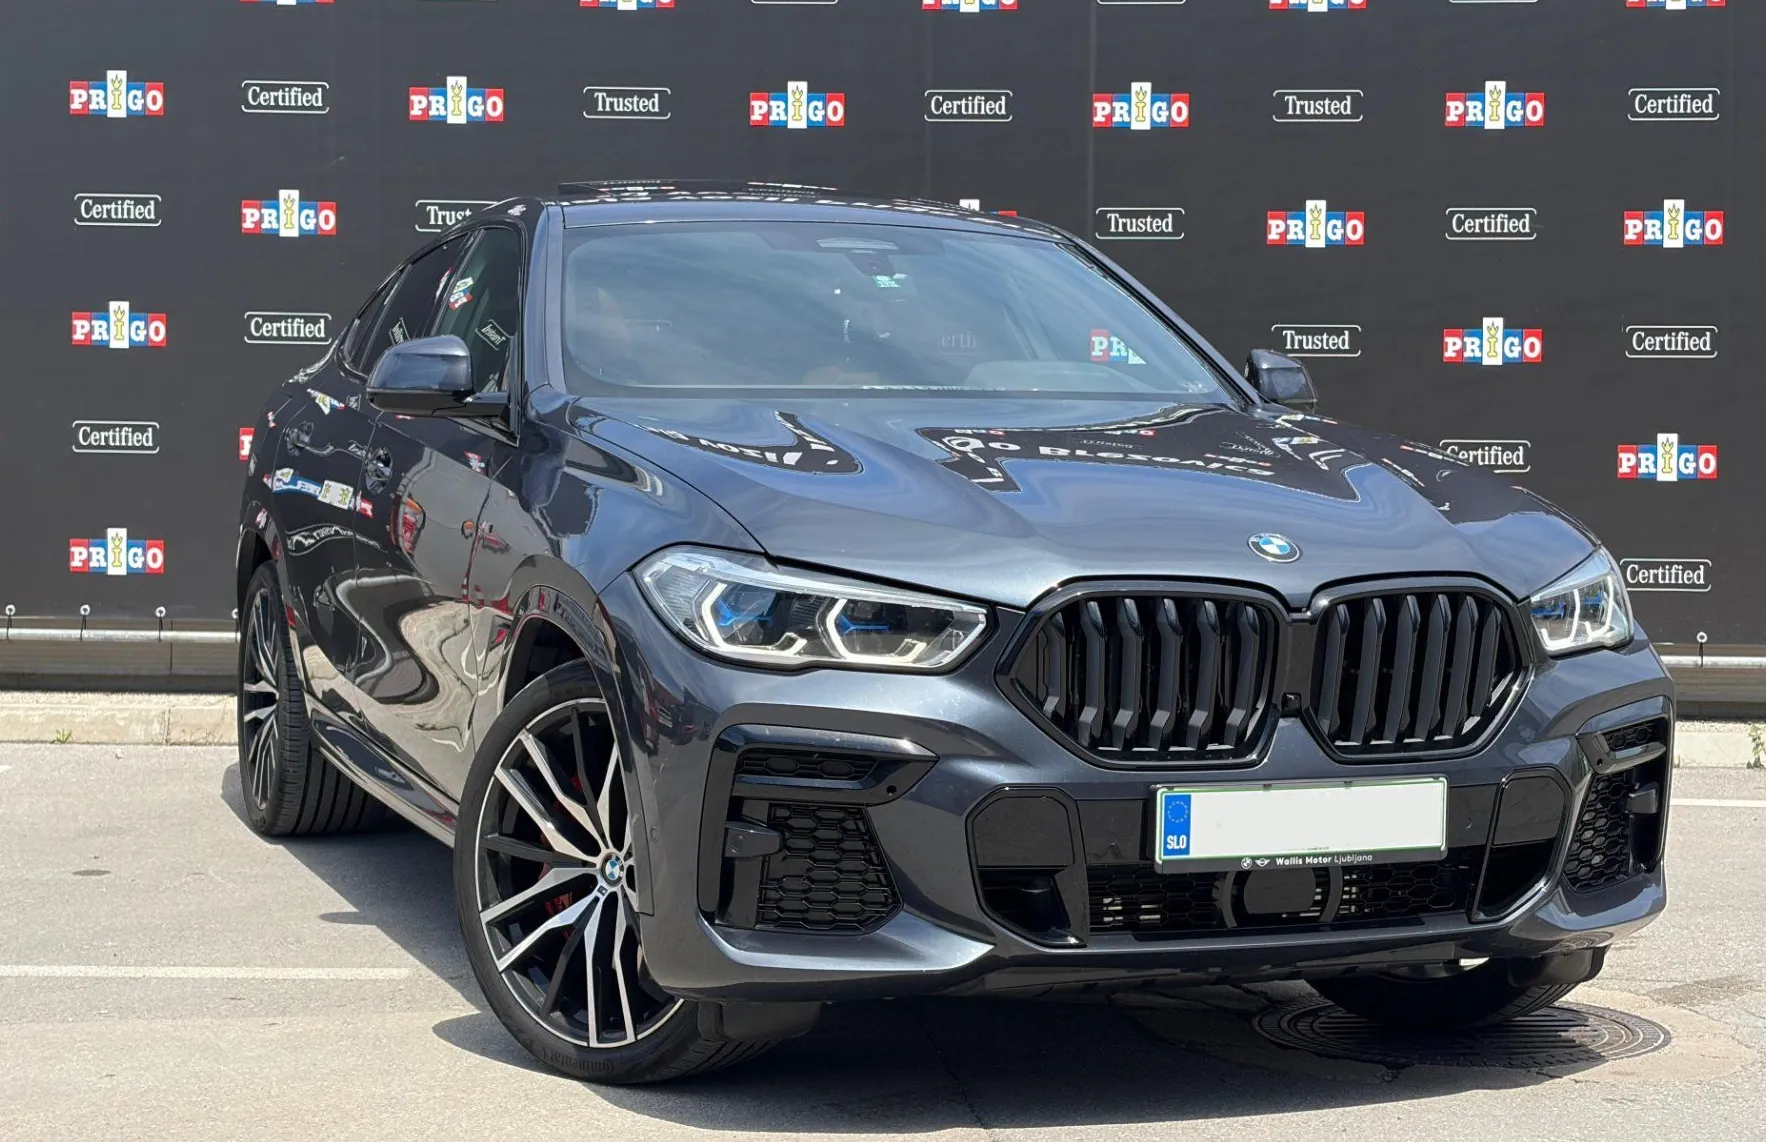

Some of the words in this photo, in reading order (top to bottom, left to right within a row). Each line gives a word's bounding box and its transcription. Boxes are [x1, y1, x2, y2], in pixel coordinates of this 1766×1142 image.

[70, 75, 164, 111] PRIGO
[247, 85, 323, 107] Certified
[410, 82, 504, 117] PRIGO
[593, 91, 660, 113] Trusted
[1634, 93, 1714, 114] Certified
[750, 87, 845, 122] PRIGO
[930, 94, 1007, 115] Certified
[1093, 88, 1188, 123] PRIGO
[1284, 94, 1352, 116] Trusted
[1446, 87, 1544, 123] PRIGO
[80, 198, 156, 220] Certified
[242, 194, 336, 230] PRIGO
[426, 205, 472, 225] Trus
[1106, 212, 1174, 233] Trusted
[1268, 206, 1364, 241] PRIGO
[1451, 213, 1531, 234] Certified
[1624, 206, 1722, 241] PRIGO
[73, 306, 166, 341] PRIGO
[250, 316, 326, 338] Certified
[1282, 329, 1350, 352] Trusted
[1444, 323, 1541, 359] PRIGO
[1632, 331, 1712, 352] Certified
[78, 425, 154, 447] Certified
[1618, 439, 1716, 474] PRIGO
[71, 533, 164, 568] PRIGO
[1626, 563, 1706, 585] Certified
[1166, 834, 1187, 850] SLO
[1275, 857, 1303, 866] Wallis
[1305, 855, 1332, 865] Motor
[1333, 853, 1373, 864] Ljubljana
